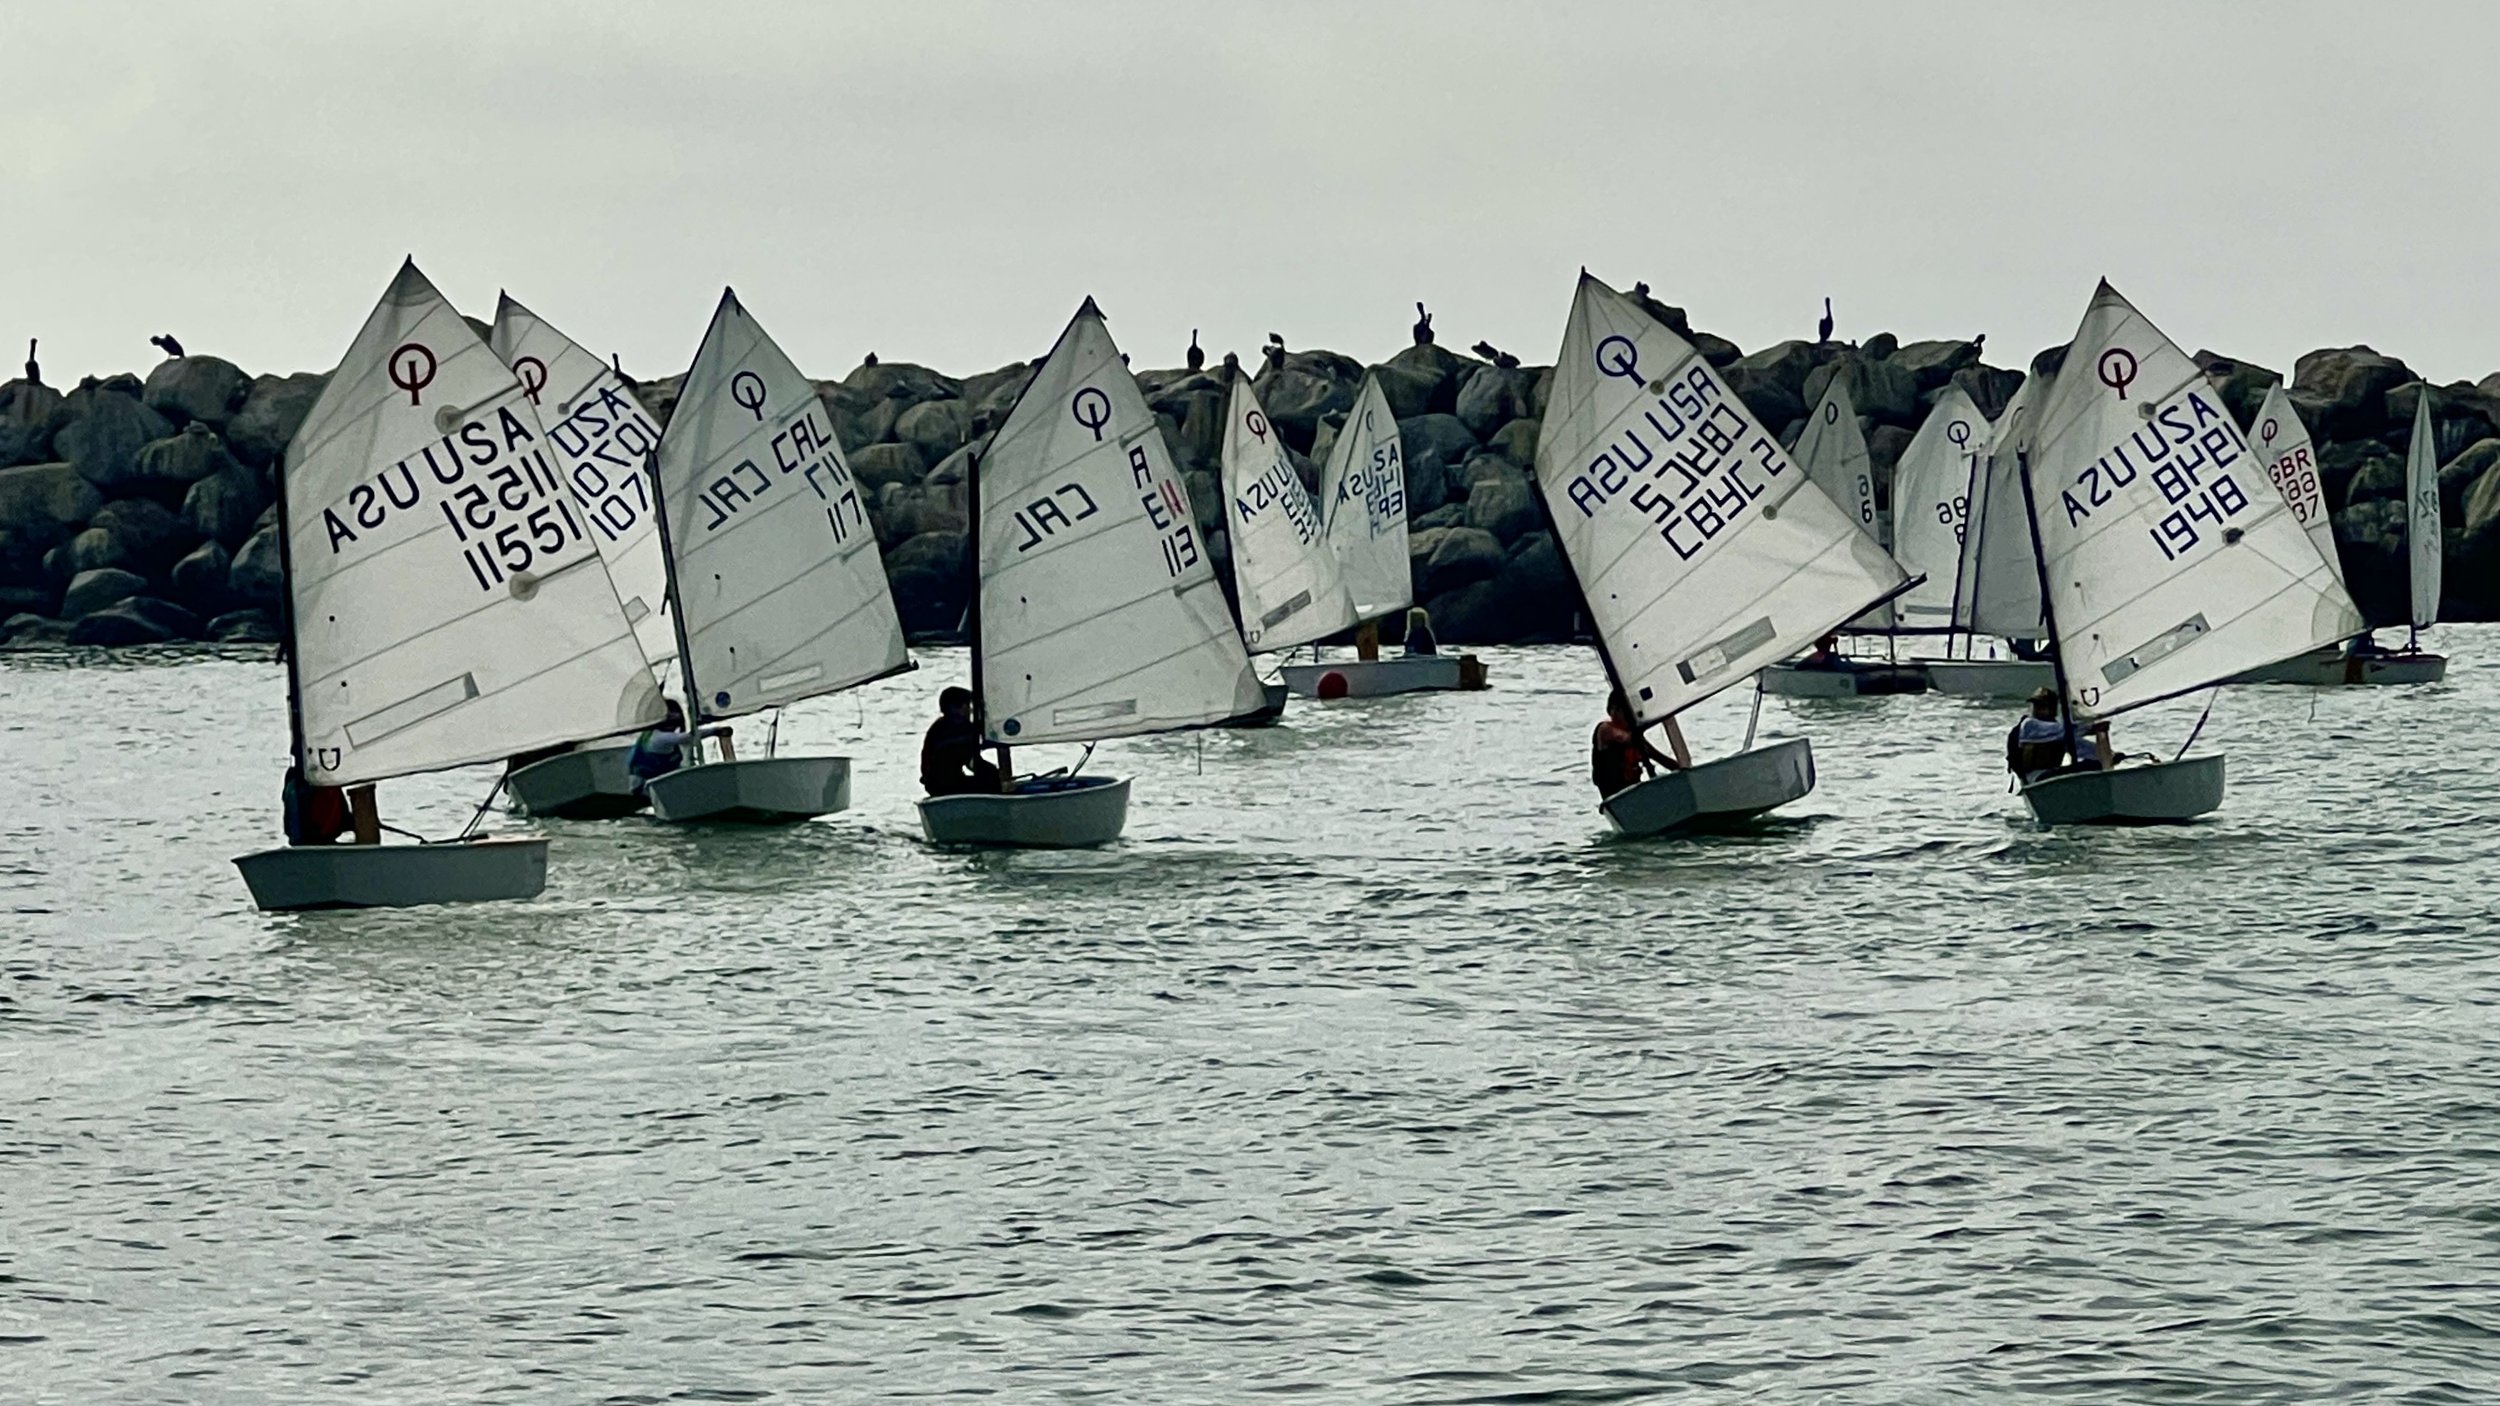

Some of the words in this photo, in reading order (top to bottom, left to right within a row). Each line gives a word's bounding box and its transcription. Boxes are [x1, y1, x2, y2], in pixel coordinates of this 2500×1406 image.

[552, 387, 631, 458] USA
[1644, 366, 1721, 443] USA
[2132, 391, 2220, 464] USA
[422, 406, 534, 485] USA
[771, 412, 832, 475] CAL
[1373, 443, 1399, 472] SA
[2267, 448, 2312, 486] GBR
[590, 471, 649, 542] 107
[827, 488, 862, 545] 117
[2150, 473, 2249, 562] 1948
[463, 499, 582, 591] 11551
[1161, 524, 1199, 578] 113
